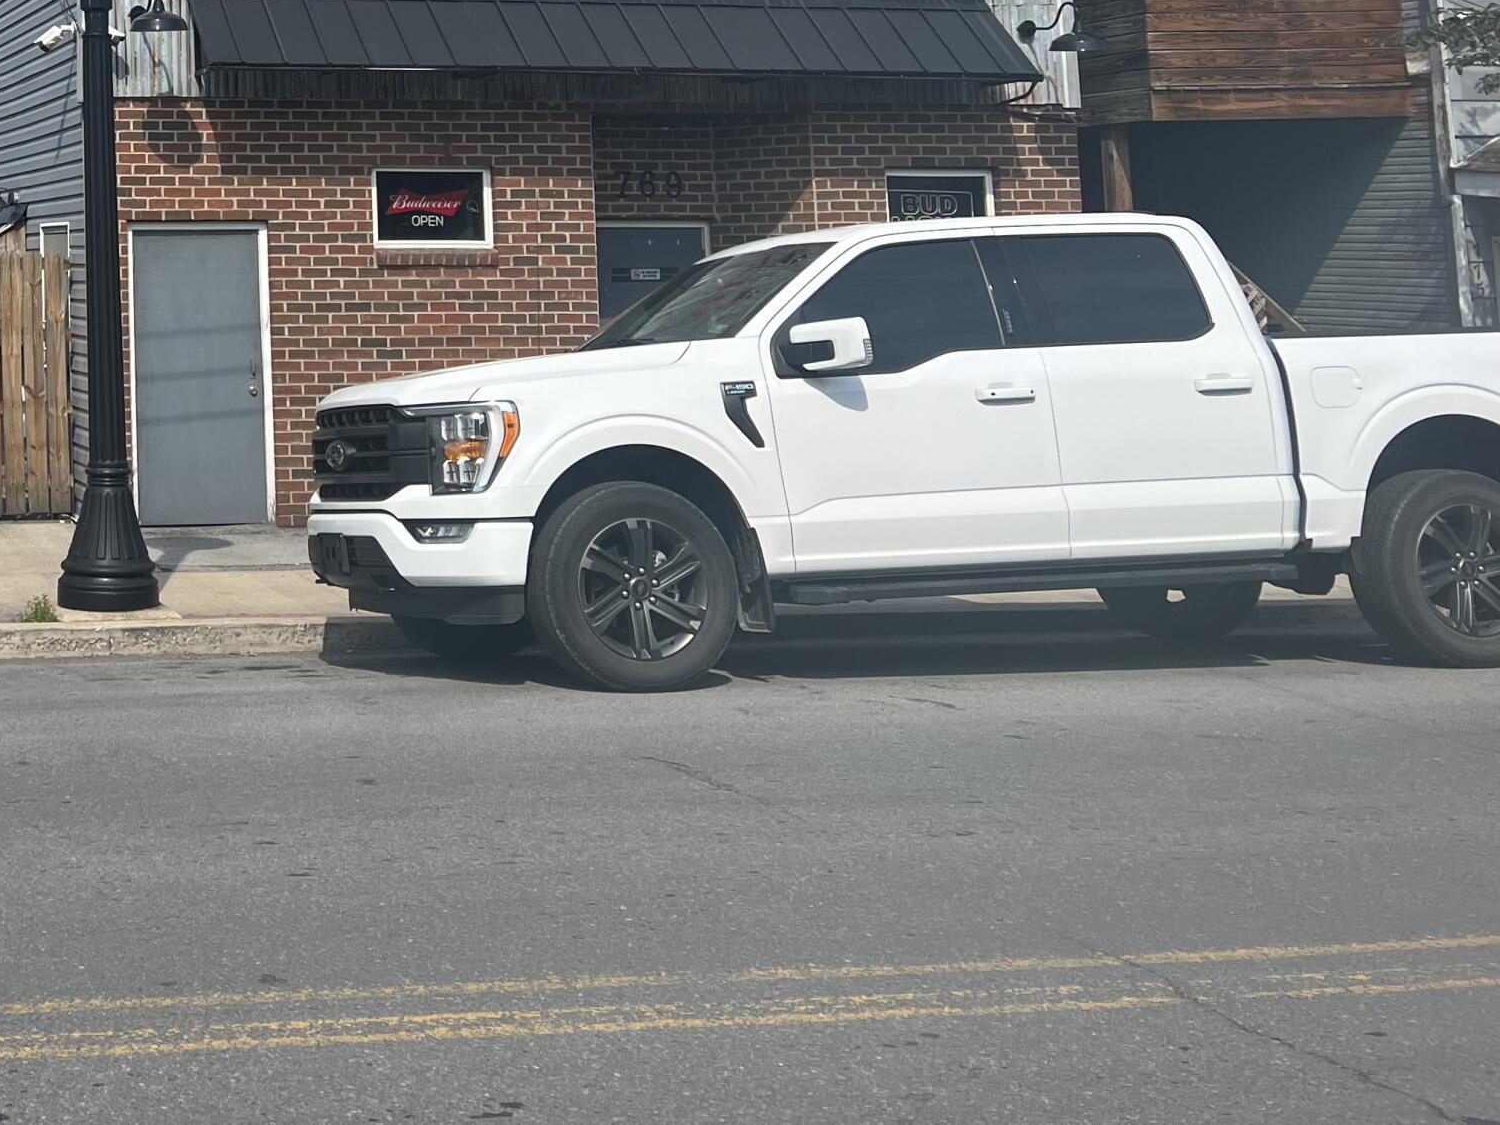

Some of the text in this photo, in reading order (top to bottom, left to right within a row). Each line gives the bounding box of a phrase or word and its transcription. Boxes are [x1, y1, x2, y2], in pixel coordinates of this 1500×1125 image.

[614, 170, 682, 198] 769
[389, 194, 461, 209] Budweiser
[900, 193, 958, 216] BUD
[411, 215, 444, 227] OPEN
